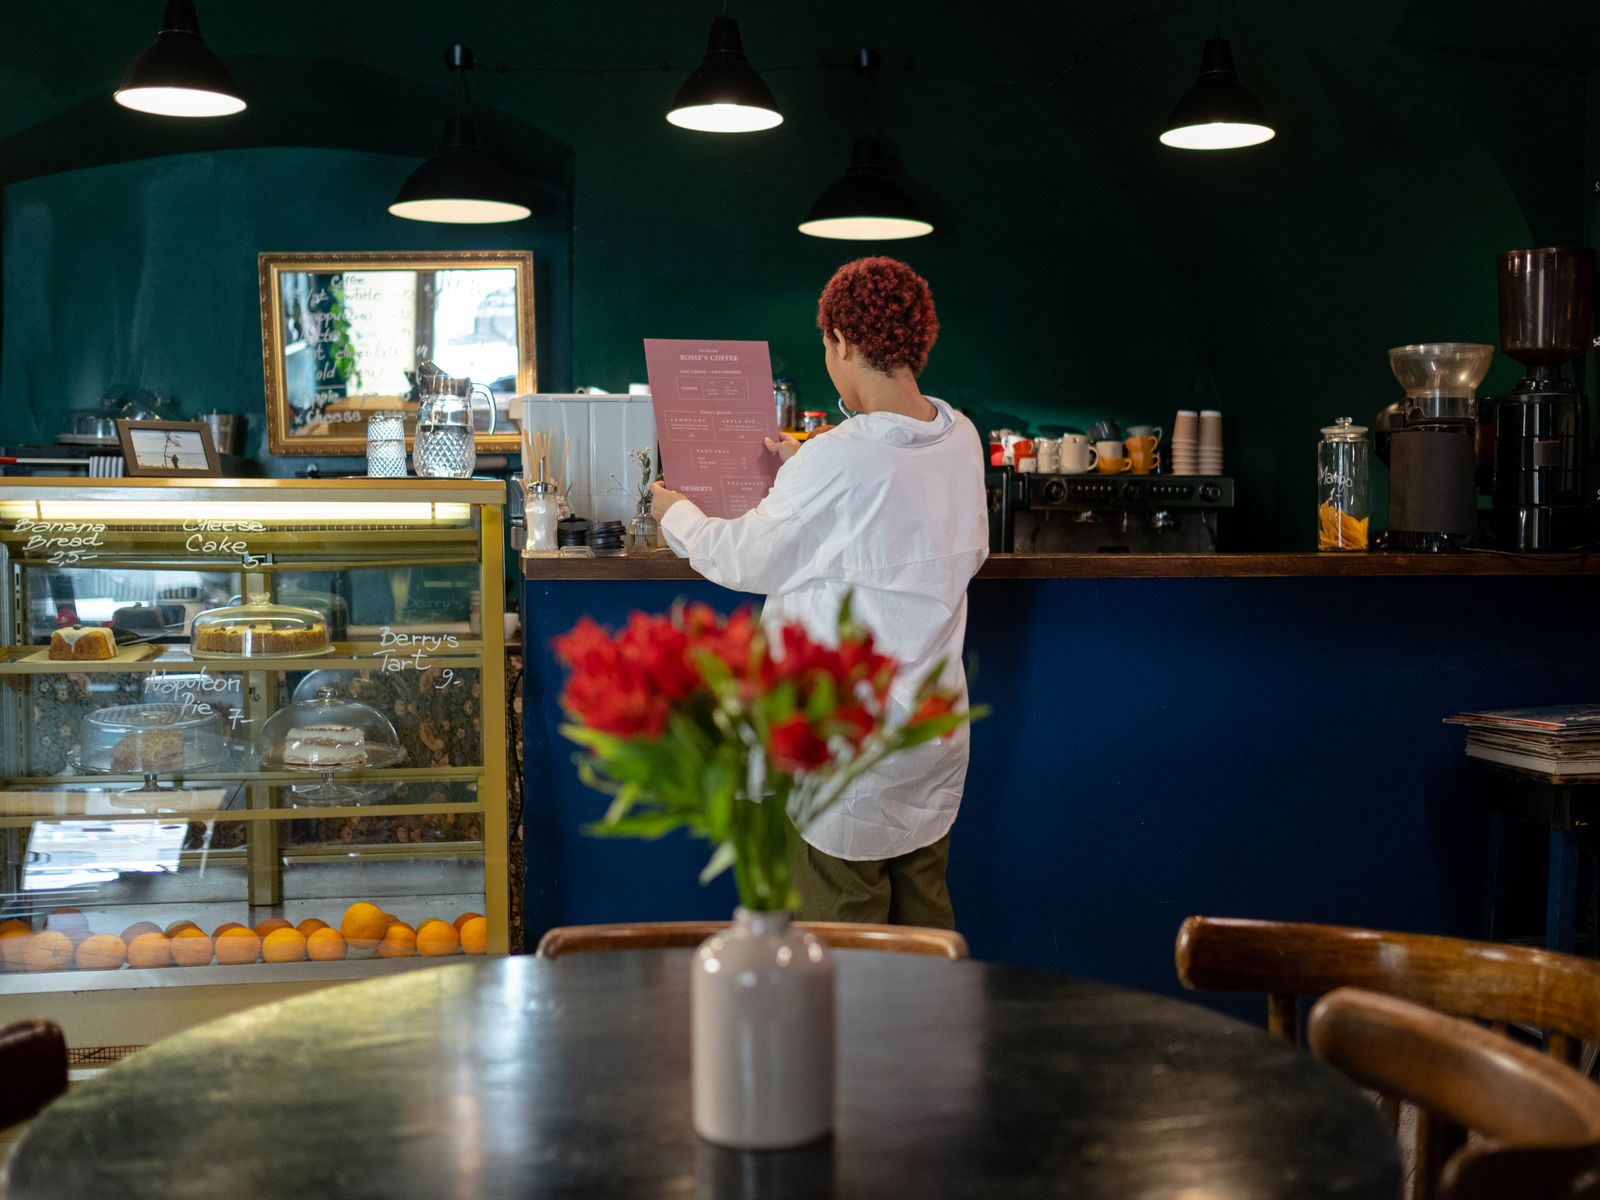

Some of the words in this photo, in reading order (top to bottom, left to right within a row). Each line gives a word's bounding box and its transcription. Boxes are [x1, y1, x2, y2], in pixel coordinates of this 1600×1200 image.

[680, 353, 708, 361] ROSIE'S
[710, 354, 739, 362] COFFEE
[1319, 466, 1353, 493] Mango
[13, 517, 106, 535] Banana
[182, 518, 266, 532] Cheese
[22, 532, 104, 551] Bread
[185, 533, 248, 555] Cake
[380, 626, 460, 650] Berry's
[373, 648, 431, 673] Tart
[144, 665, 240, 702] Napoleon
[180, 691, 213, 716] Pie
